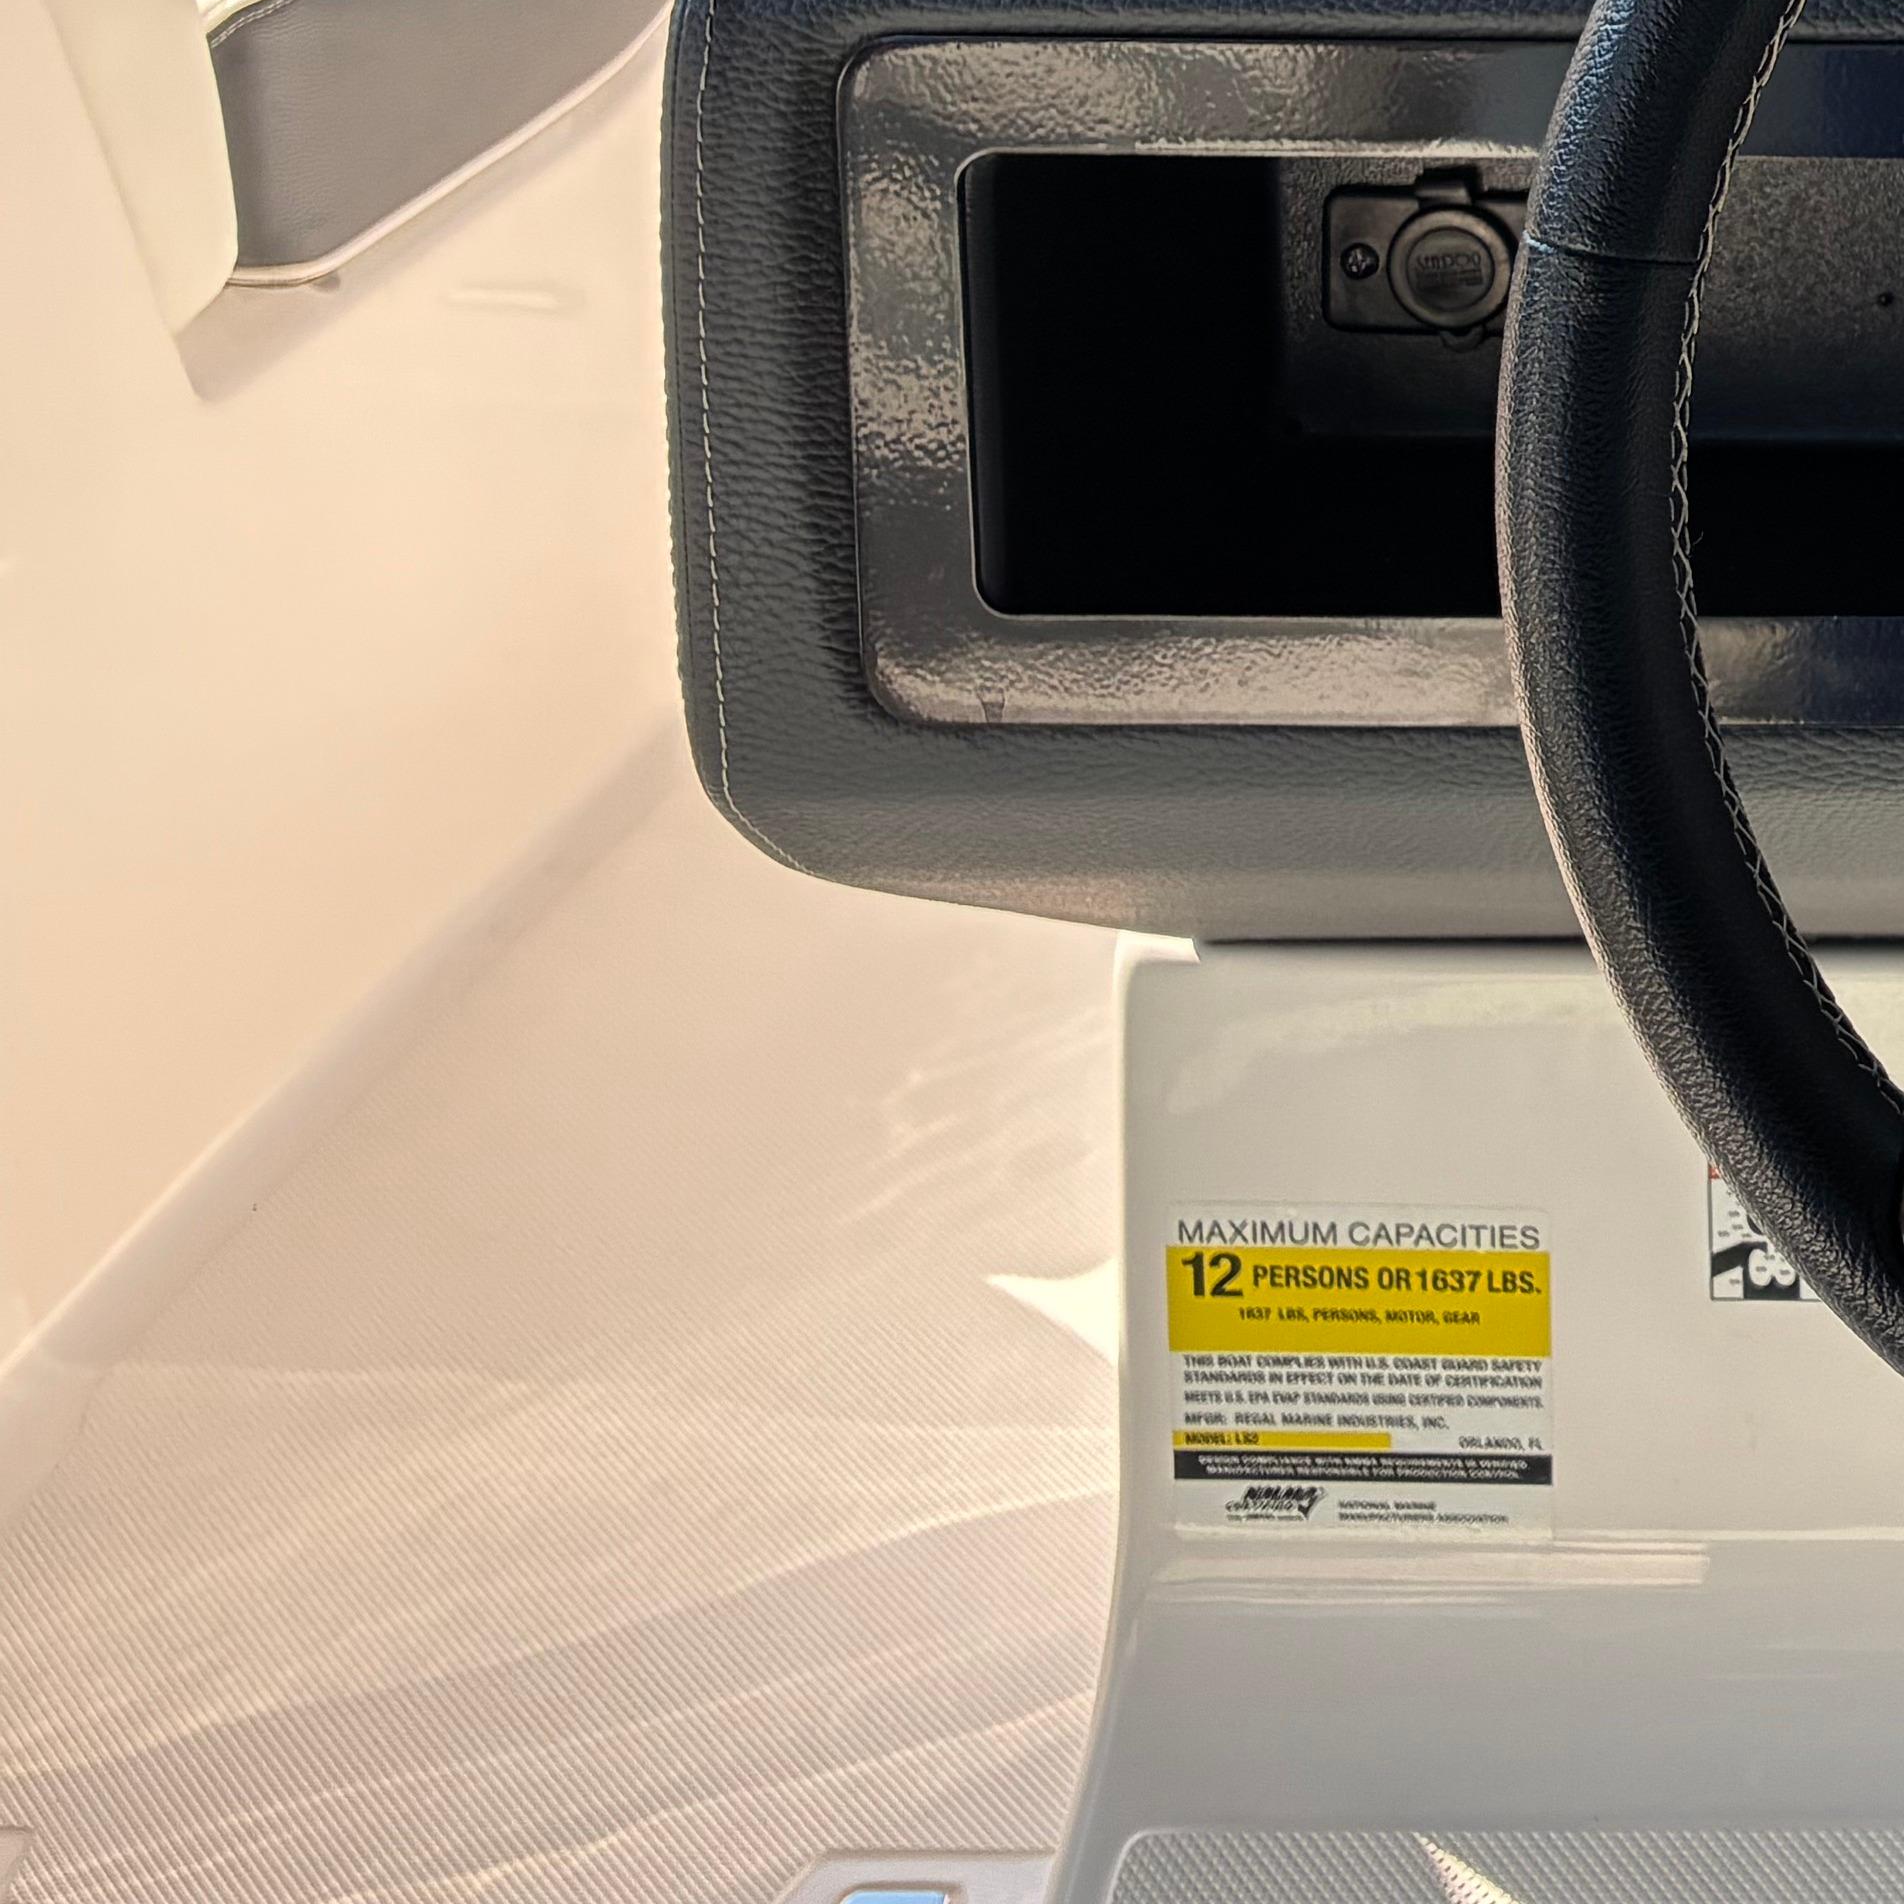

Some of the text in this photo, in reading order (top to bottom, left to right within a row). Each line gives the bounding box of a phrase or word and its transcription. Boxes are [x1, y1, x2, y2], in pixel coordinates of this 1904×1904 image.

[1178, 1219, 1540, 1250] MAXIMUM CAPACITIES
[1181, 1251, 1542, 1298] 12 PERSONS OR 1637 LBS.
[1239, 1307, 1271, 1320] 1637
[1443, 1311, 1480, 1324] GEAR
[1184, 1354, 1214, 1367] THIS
[1217, 1355, 1252, 1368] BOAT
[1256, 1355, 1326, 1369] COMPLIES
[1327, 1356, 1363, 1369] WITH
[1393, 1357, 1437, 1370] COAST
[1441, 1358, 1488, 1371] GUARD
[1491, 1359, 1542, 1372] SAFETY
[1184, 1370, 1542, 1389] STANDARDS IN EFFECT ON THE DATE OF CERTIFICATION
[1235, 1412, 1276, 1425] REGAL
[1281, 1413, 1332, 1426] MARINE
